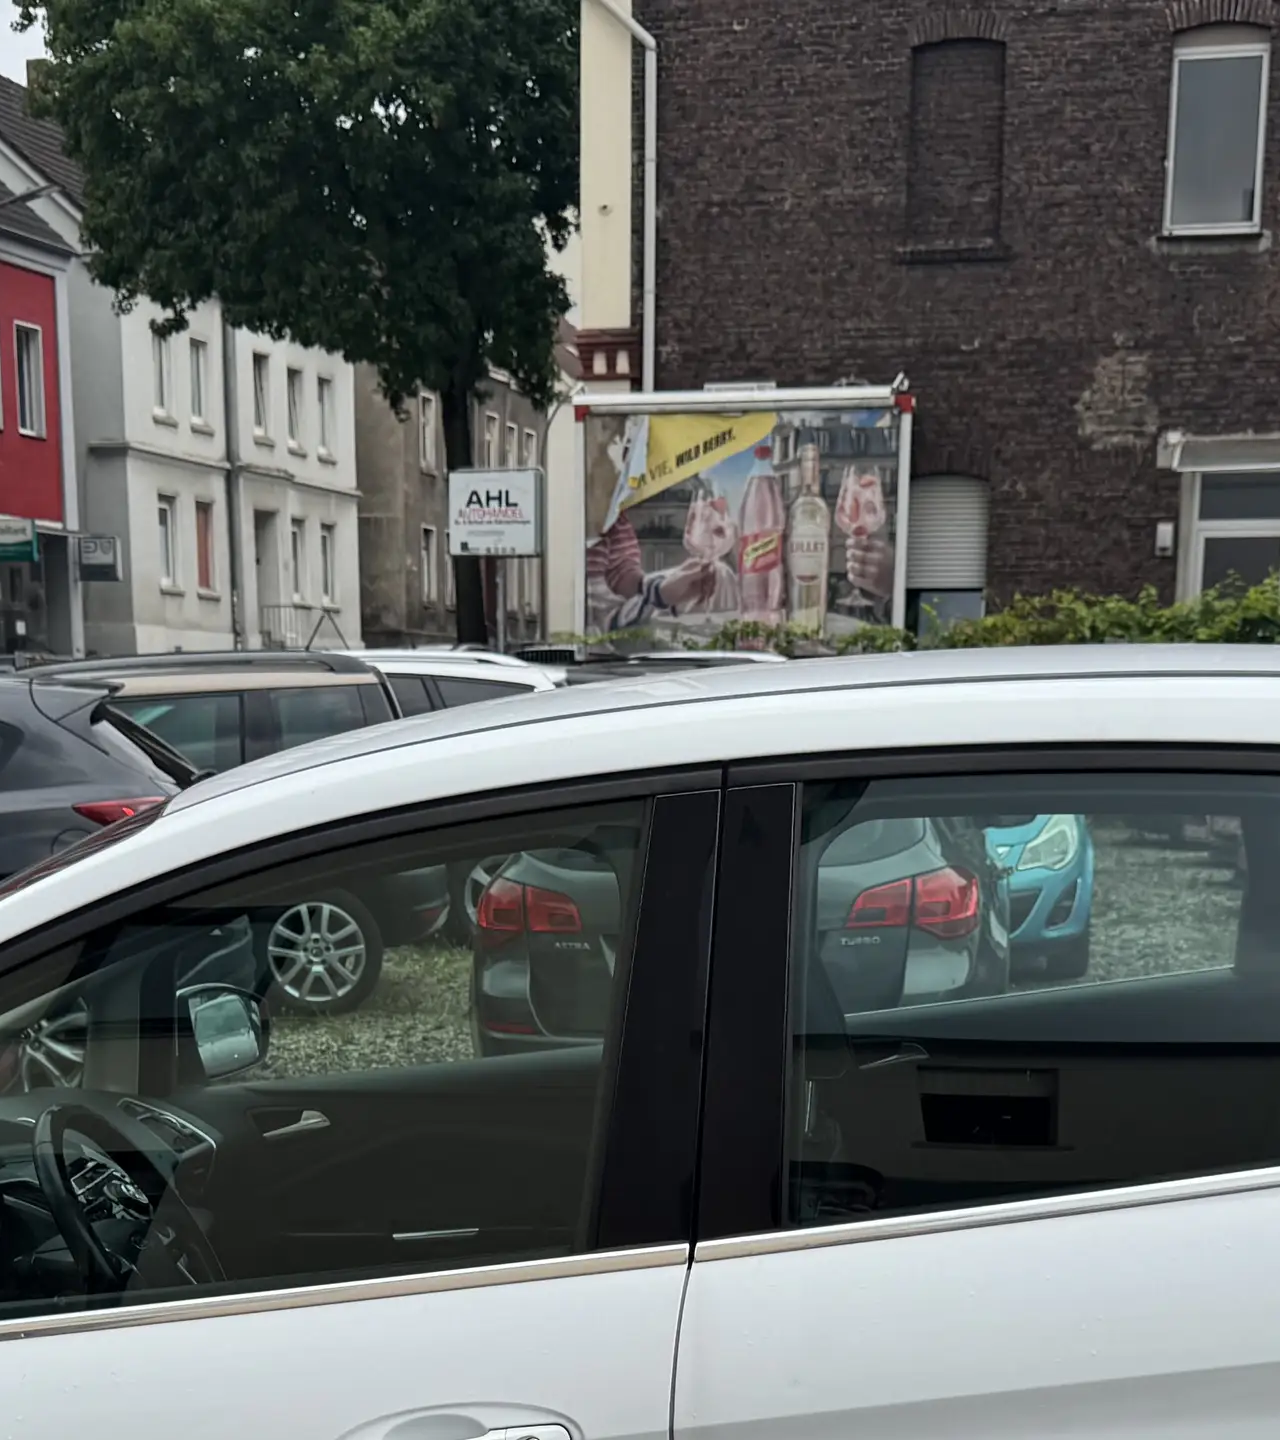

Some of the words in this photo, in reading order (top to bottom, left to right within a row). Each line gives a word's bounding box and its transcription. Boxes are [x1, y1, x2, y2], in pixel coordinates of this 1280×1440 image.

[675, 444, 701, 468] WILD
[702, 426, 736, 455] BERRY.
[466, 490, 518, 508] AHL
